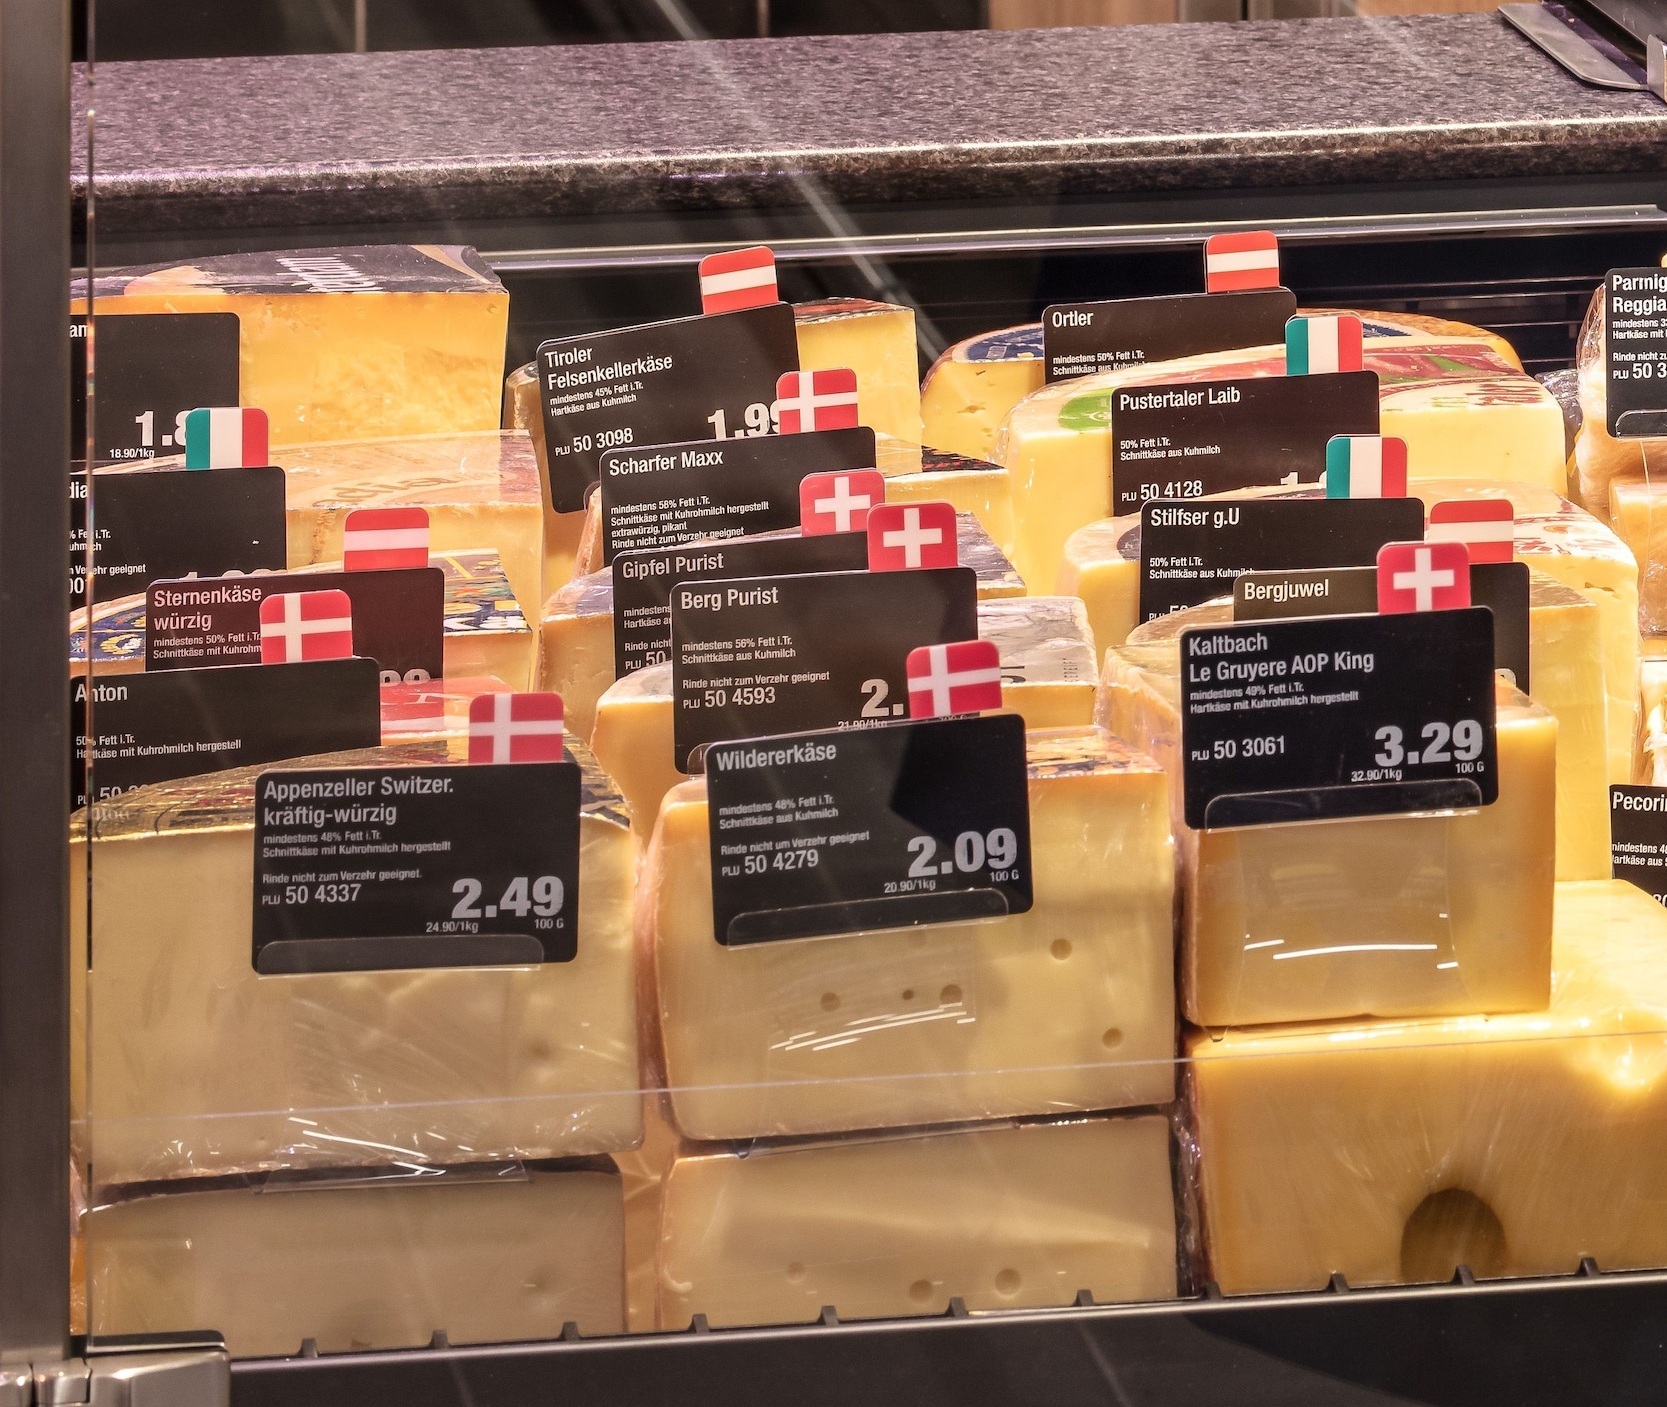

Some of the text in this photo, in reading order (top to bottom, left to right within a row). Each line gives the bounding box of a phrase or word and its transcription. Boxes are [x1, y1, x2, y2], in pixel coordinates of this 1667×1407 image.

[1052, 310, 1094, 328] Ortler
[544, 347, 592, 368] Tiroler
[547, 355, 672, 390] Felsenkellerkäse
[1612, 369, 1629, 379] PLU
[1632, 362, 1652, 379] 50
[1119, 386, 1240, 411] Pustertaler Laib
[609, 450, 723, 476] Scharfer Maxx
[661, 520, 687, 534] pikant
[1150, 507, 1239, 528] Stilfser g.U
[622, 552, 724, 580] Gipfel Purist
[154, 586, 265, 607] Sternenkäse
[681, 586, 778, 611] Berg Purist
[1244, 578, 1329, 602] Bergjuwel
[153, 611, 211, 631] würzig
[1189, 632, 1268, 656] Kaltbach
[1189, 651, 1374, 682] Le Gruyere AOP King
[1191, 735, 1284, 761] PLU 50 3061
[1374, 719, 1483, 767] 3.29
[716, 742, 836, 771] Wildererkäse
[1351, 768, 1402, 782] 32.90/1kg
[263, 775, 453, 802] Appenzeller Switzer.
[264, 802, 397, 828] kräftig-würzig
[907, 827, 1017, 878] 2.09
[262, 883, 361, 905] PLU 50 4337
[451, 875, 564, 919] 2.49
